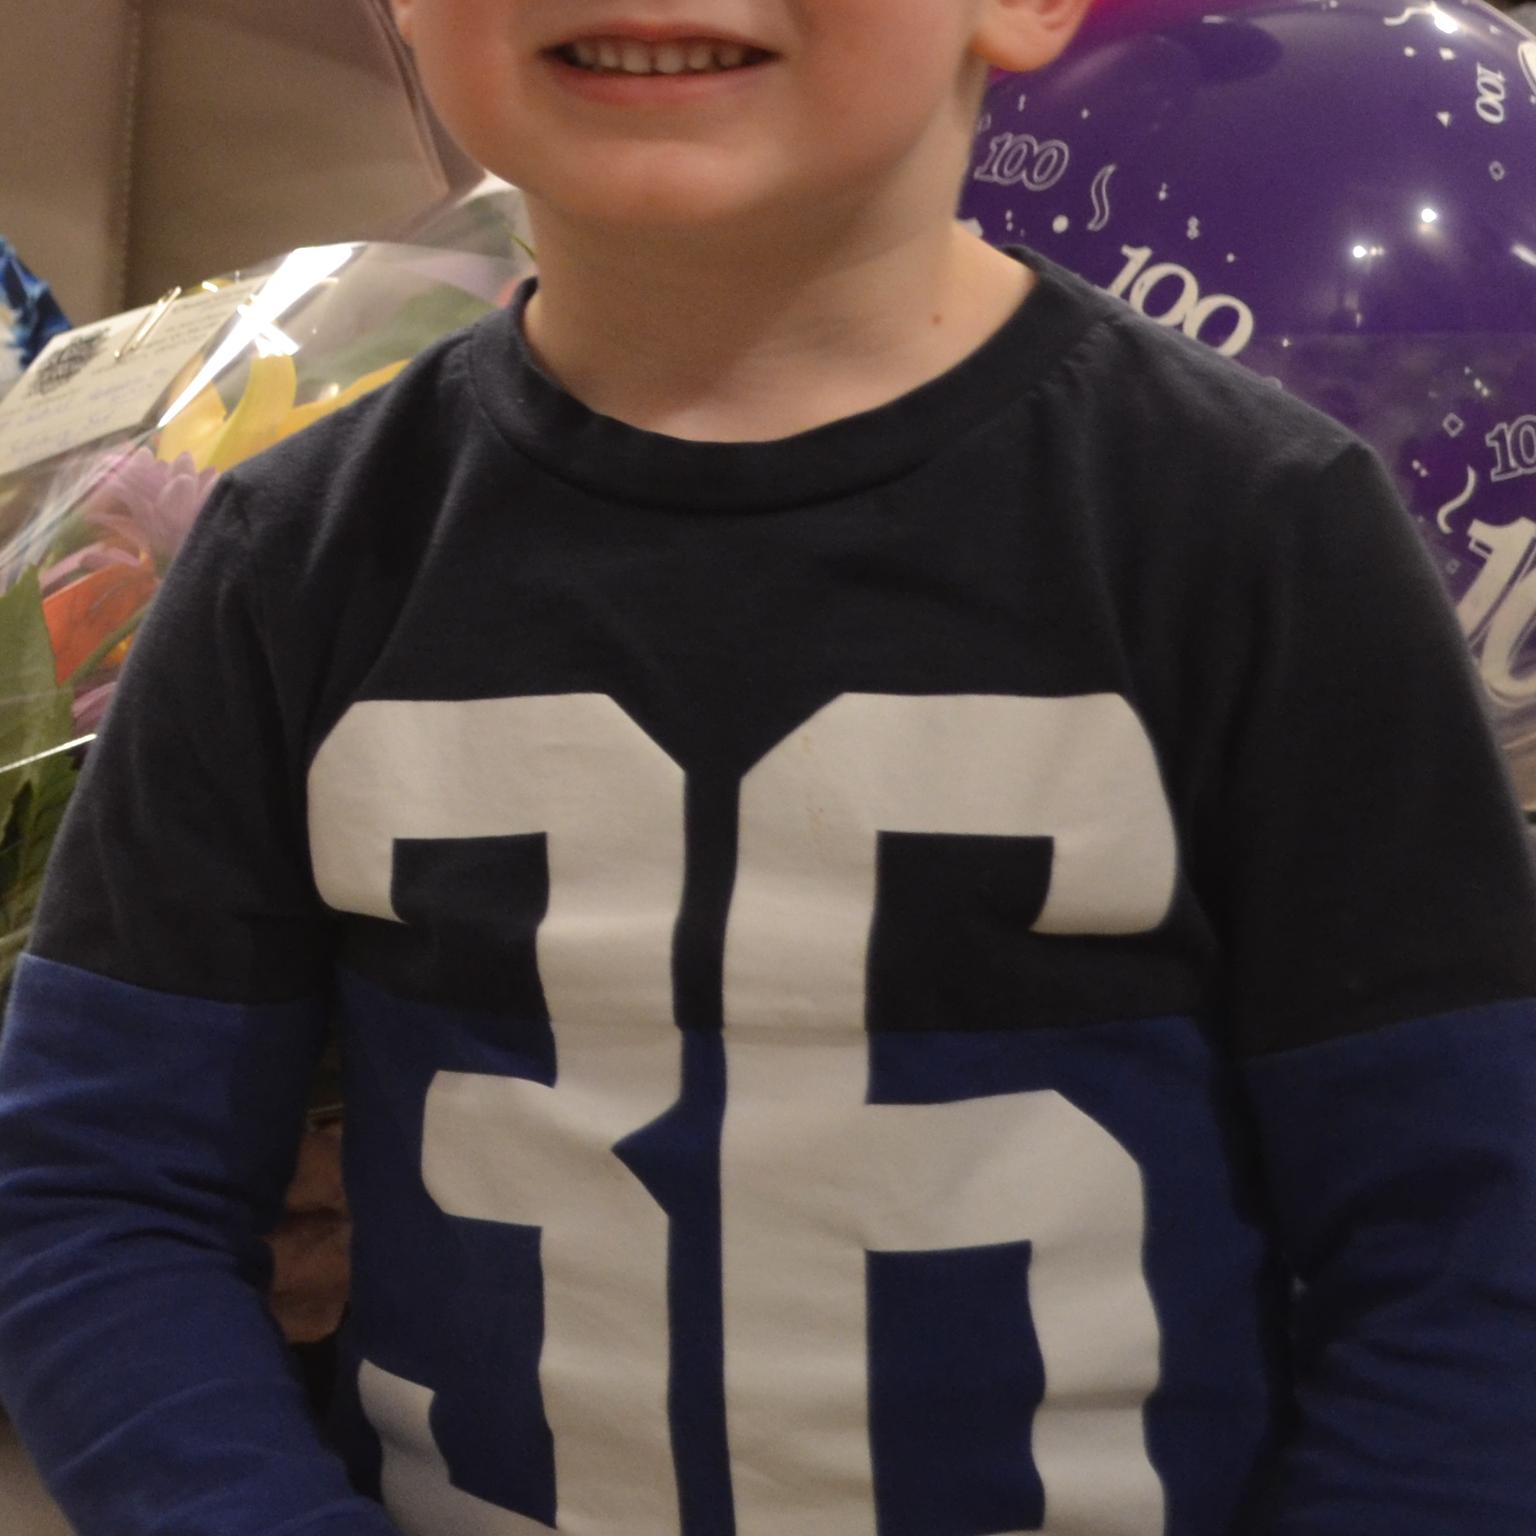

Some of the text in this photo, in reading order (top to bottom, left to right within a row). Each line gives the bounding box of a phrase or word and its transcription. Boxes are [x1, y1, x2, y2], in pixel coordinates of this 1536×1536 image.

[1474, 61, 1506, 125] 100
[973, 132, 1070, 192] 100
[1101, 244, 1254, 357] 100
[307, 692, 1178, 1536] 36
